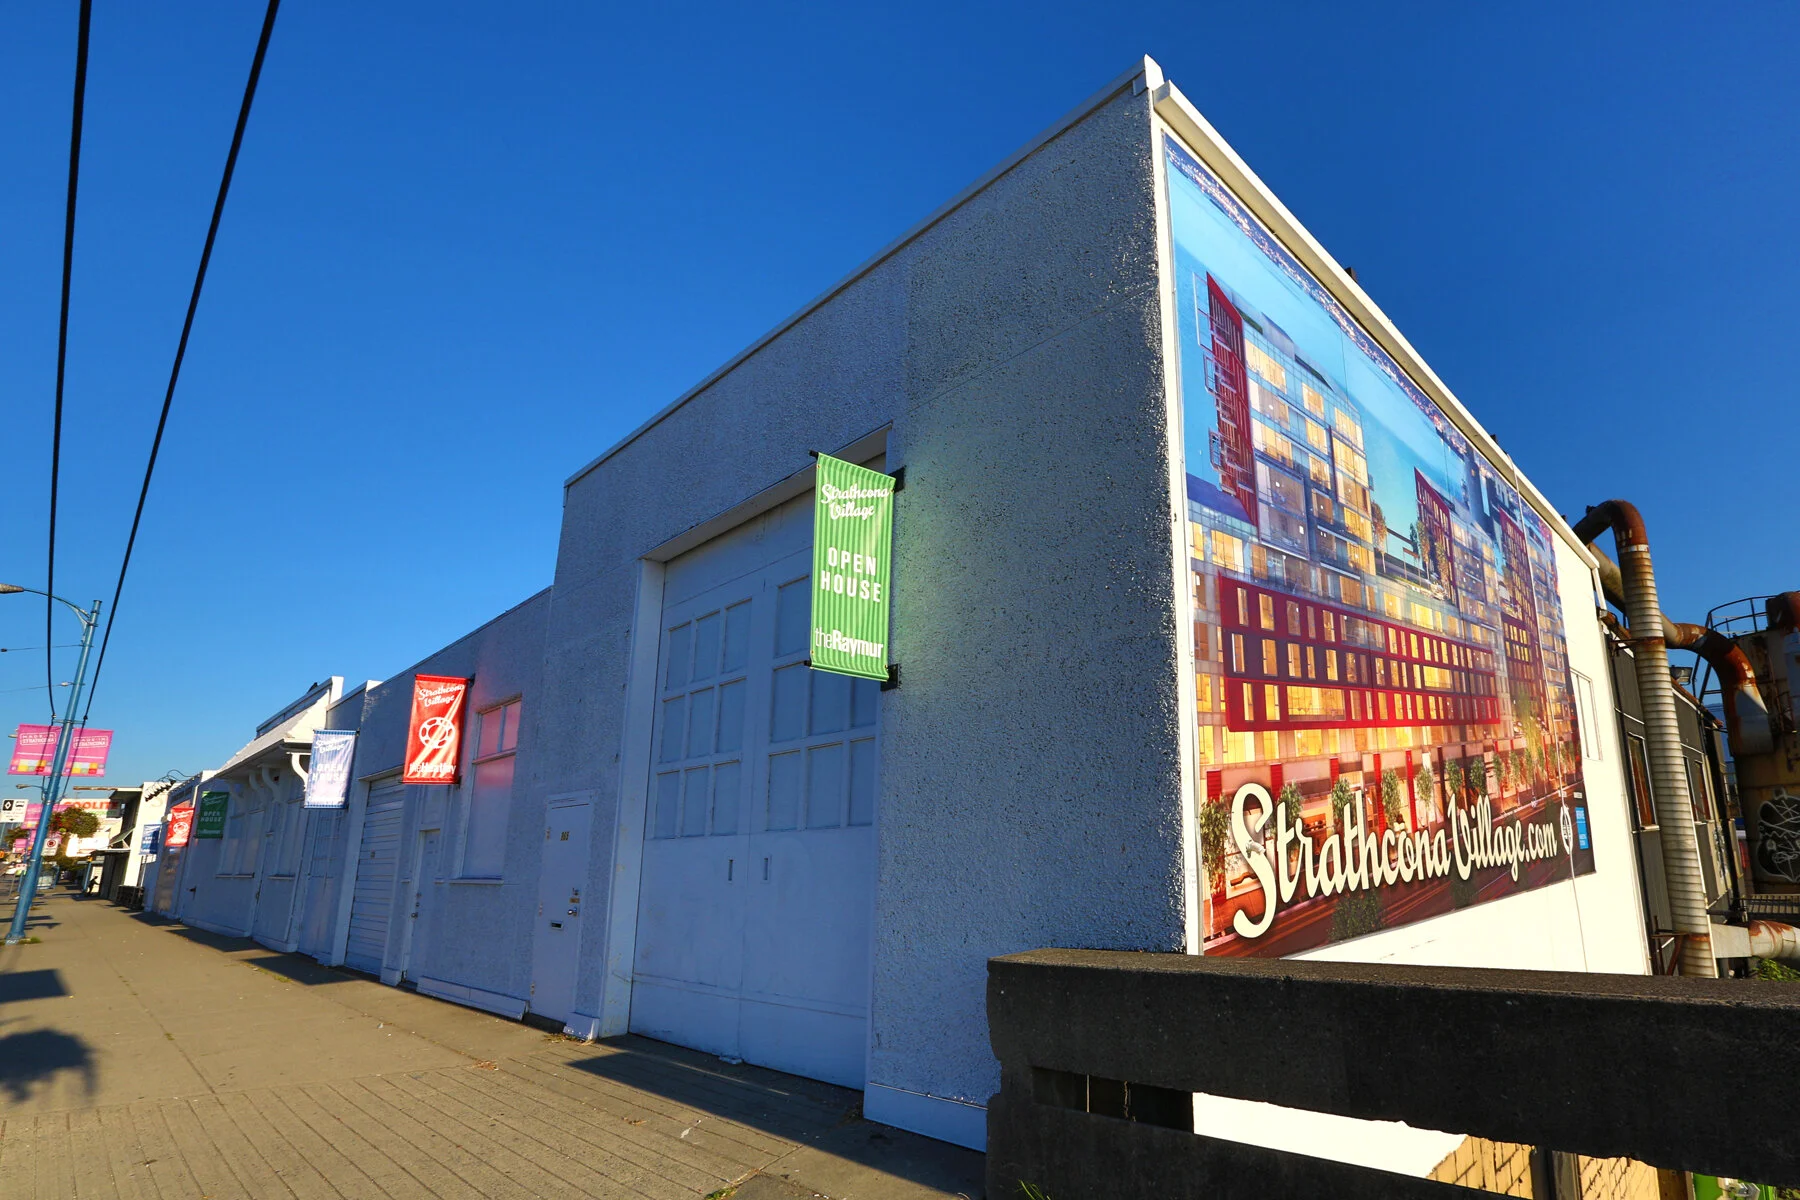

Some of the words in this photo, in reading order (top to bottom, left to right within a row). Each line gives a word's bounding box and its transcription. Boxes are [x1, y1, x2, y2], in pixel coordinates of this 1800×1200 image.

[821, 483, 889, 505] Strathcona
[830, 501, 875, 521] Village
[828, 547, 877, 577] OPEN
[820, 570, 882, 603] HOUSE
[815, 626, 884, 659] theRaymur
